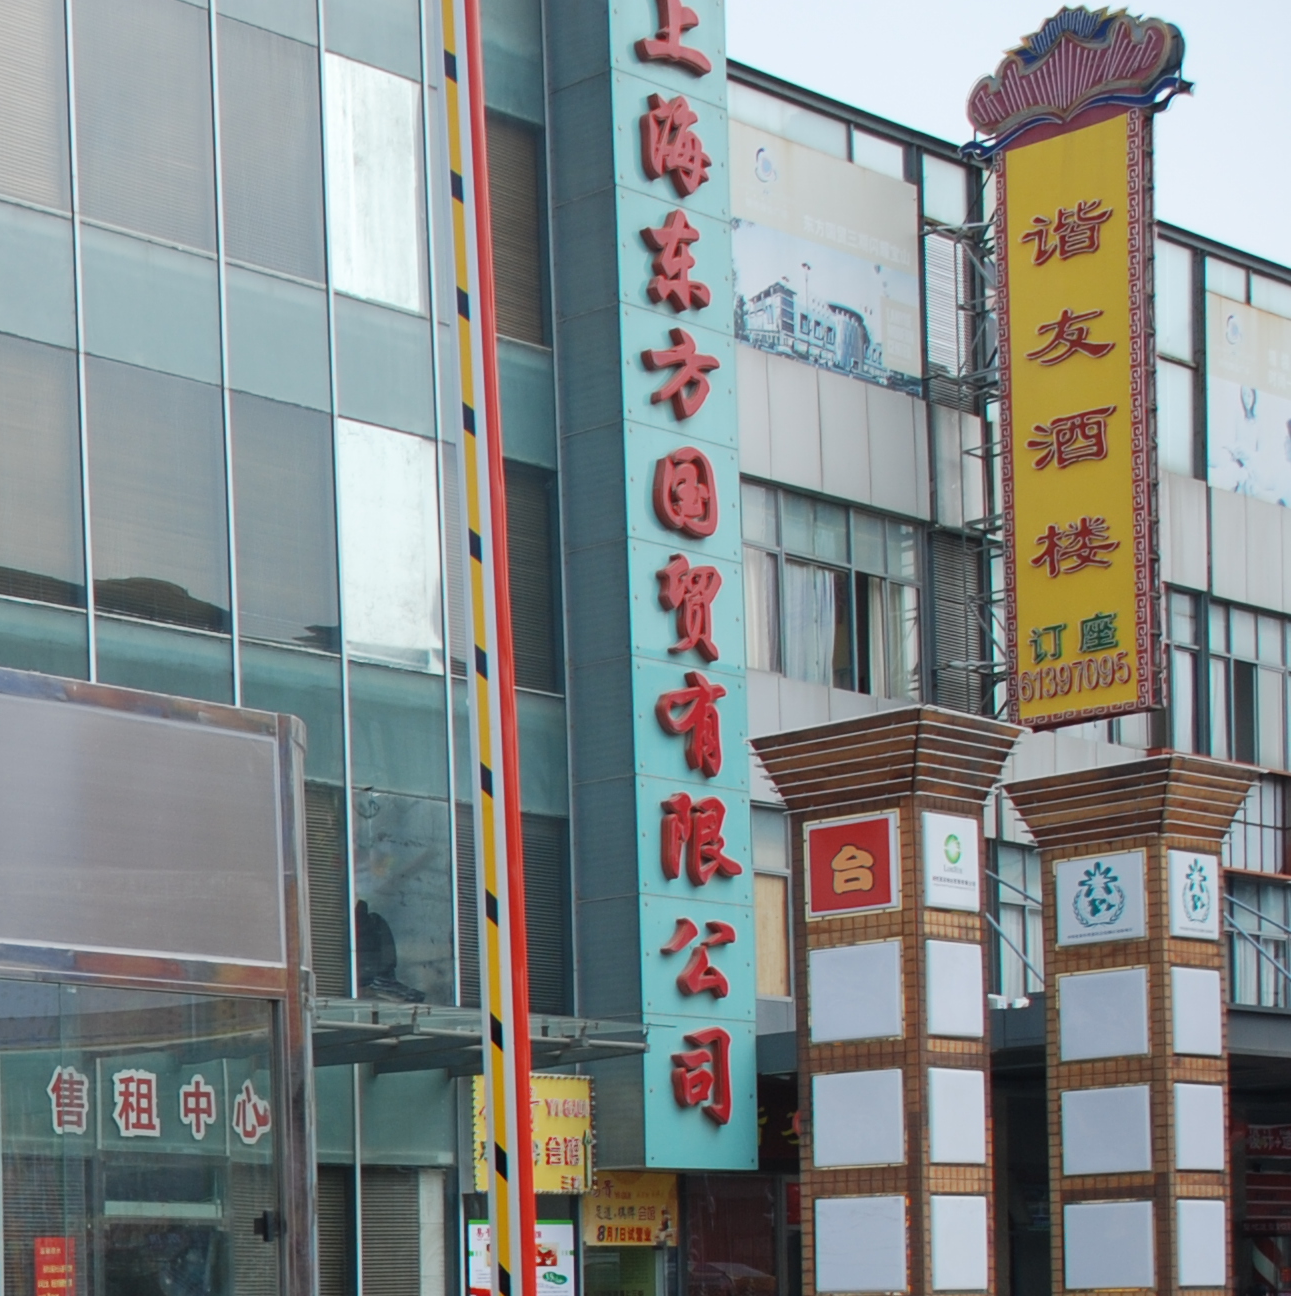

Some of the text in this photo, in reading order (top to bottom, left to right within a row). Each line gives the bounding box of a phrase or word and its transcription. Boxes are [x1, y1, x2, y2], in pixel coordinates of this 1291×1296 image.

[1019, 198, 1122, 579] 谐友酒楼
[1028, 611, 1121, 664] 订座
[1018, 650, 1132, 703] 61397095
[831, 844, 875, 895] 台
[48, 1066, 271, 1144] 售租中心
